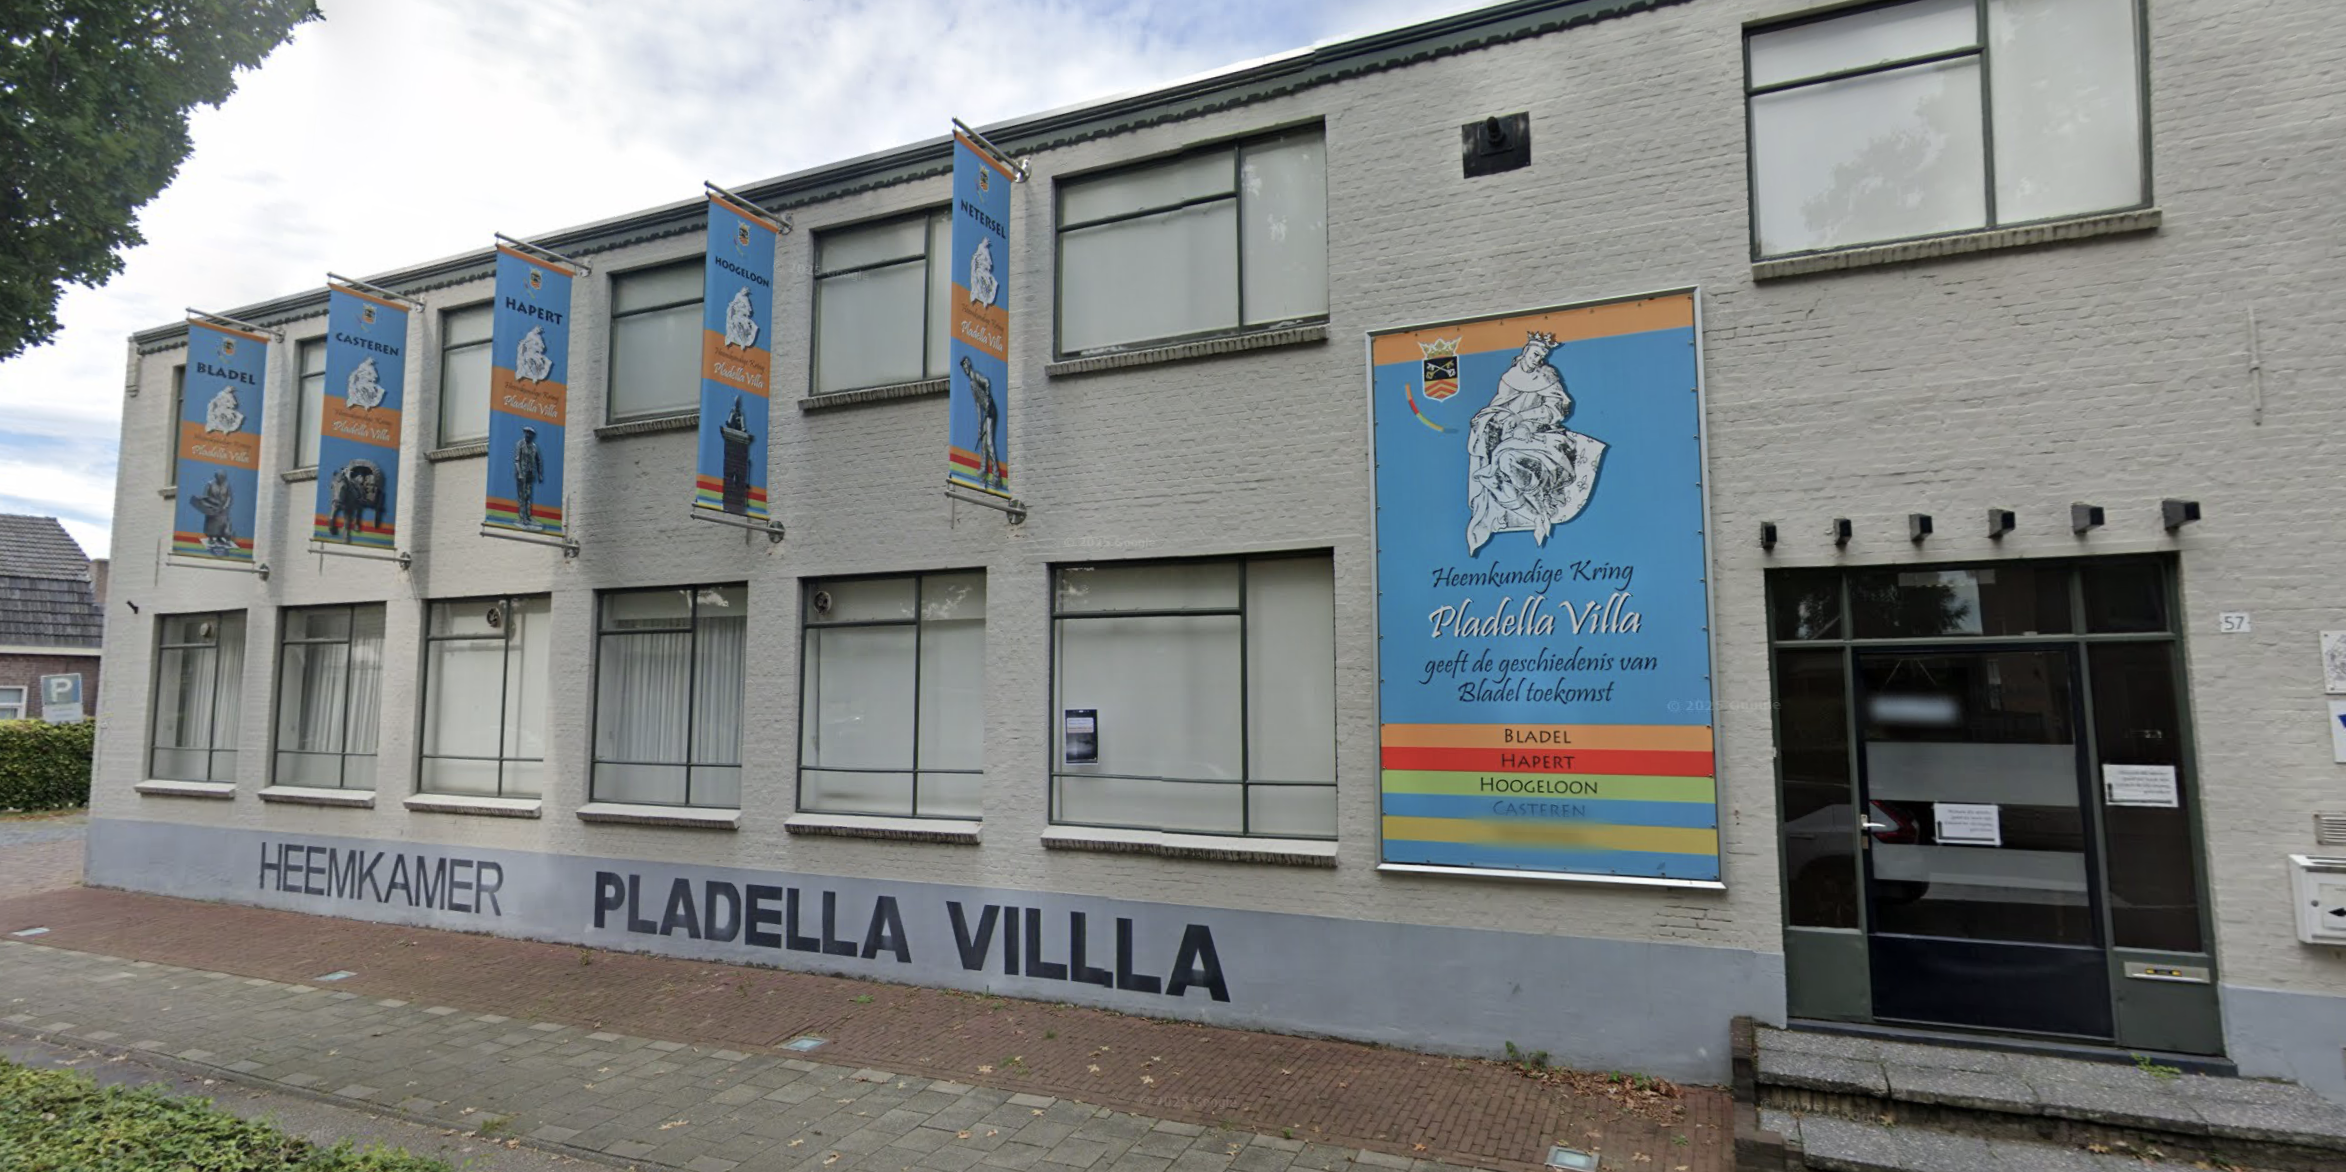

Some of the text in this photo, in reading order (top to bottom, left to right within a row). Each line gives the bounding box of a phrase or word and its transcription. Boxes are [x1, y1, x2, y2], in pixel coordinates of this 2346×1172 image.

[961, 199, 1006, 239] NETERSEL
[715, 256, 769, 288] HOOGELOON
[505, 296, 563, 325] HAPERT
[335, 332, 399, 357] CASTEREN
[197, 362, 256, 385] BLADEL
[1432, 559, 1634, 594] Heemkundige Kring
[1429, 592, 1643, 638] Pladella Villa
[2224, 616, 2245, 630] 57
[1419, 646, 1658, 684] geeft de geschiedenis van
[50, 678, 73, 702] P
[1458, 677, 1615, 704] Bladel toekomst
[1504, 728, 1572, 744] BLADEL
[1500, 753, 1576, 769] HAPERT
[1480, 777, 1598, 795] HOOGELOON
[260, 841, 504, 916] HEEMKAMER
[594, 871, 912, 964] PLADELLA
